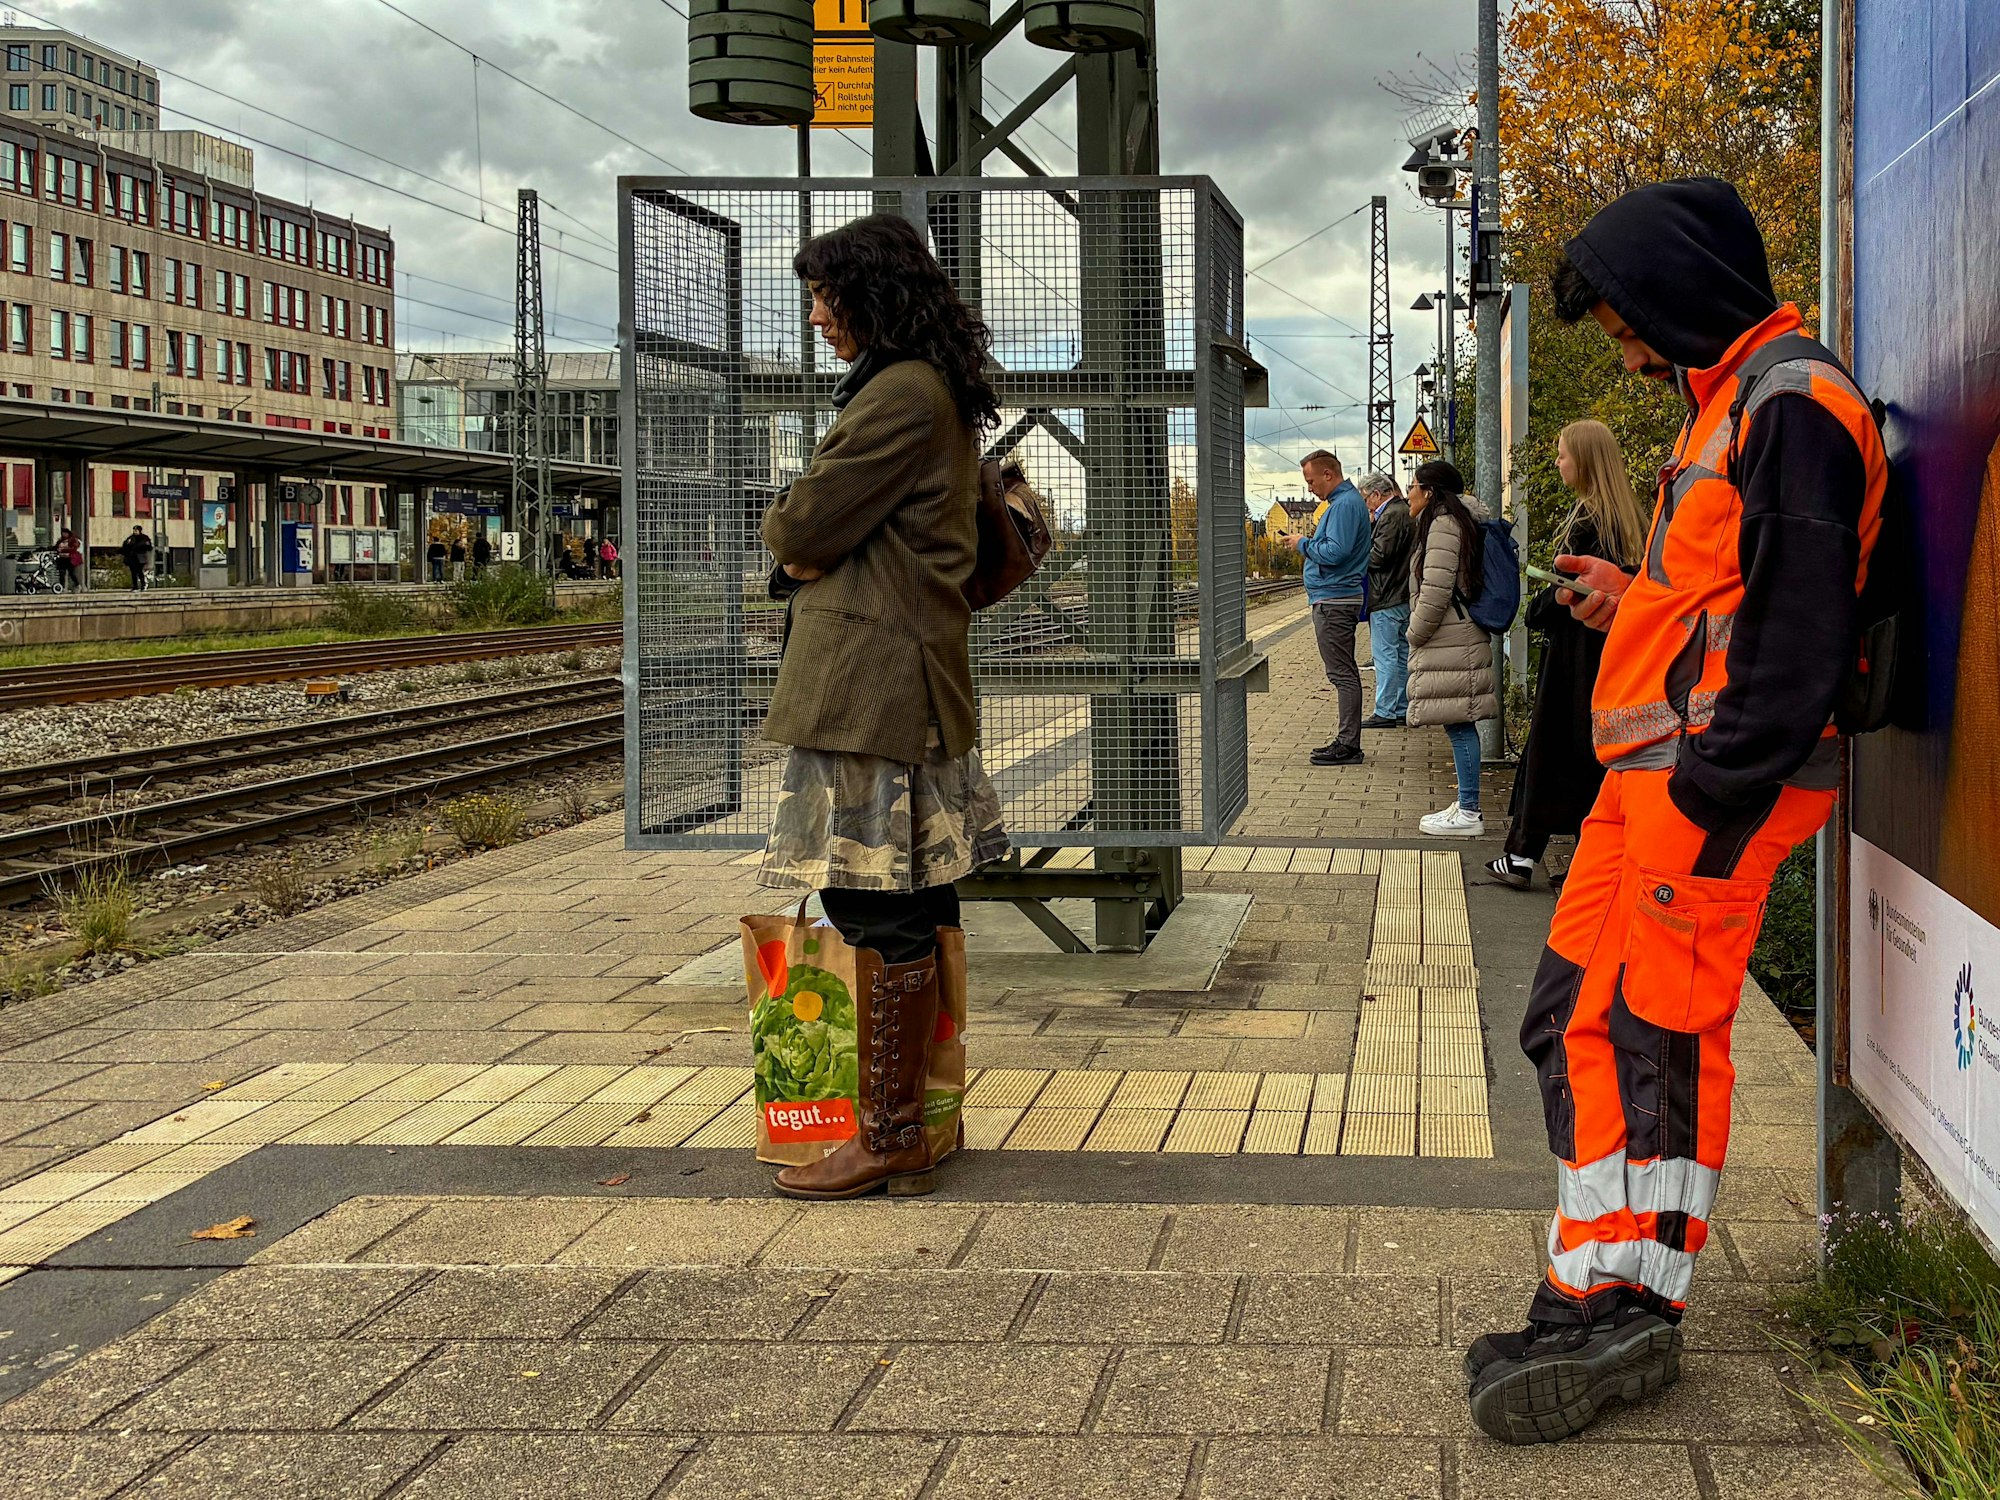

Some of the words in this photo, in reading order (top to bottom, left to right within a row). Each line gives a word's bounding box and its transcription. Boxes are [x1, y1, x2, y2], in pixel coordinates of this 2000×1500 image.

[219, 487, 229, 499] B
[285, 486, 295, 499] B
[507, 534, 514, 545] 3
[507, 547, 514, 557] 4
[1658, 889, 1669, 899] FE
[1886, 899, 1927, 946] Bundesministerium
[1893, 929, 1917, 964] Gesundheit
[936, 1097, 954, 1106] Gutes
[768, 1105, 846, 1131] tegut...
